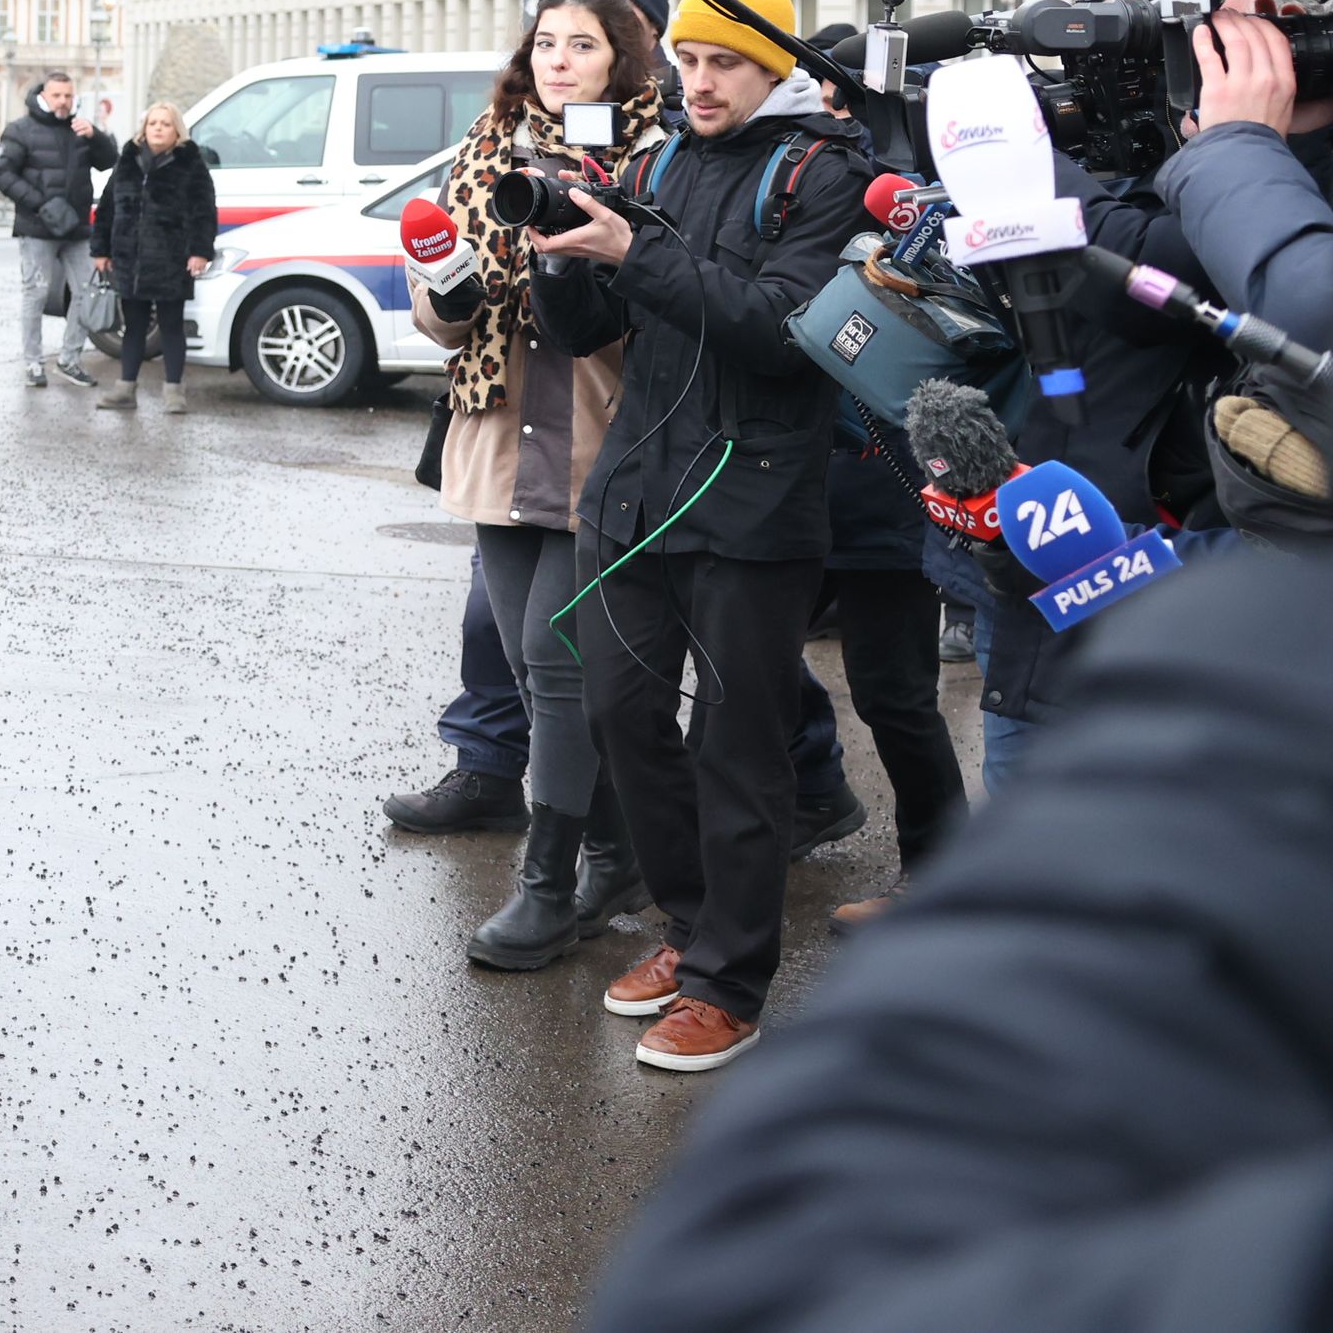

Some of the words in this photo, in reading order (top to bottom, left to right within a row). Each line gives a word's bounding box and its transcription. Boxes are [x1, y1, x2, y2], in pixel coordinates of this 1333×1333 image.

[411, 229, 450, 249] Kronen
[415, 239, 453, 258] Zeitung
[900, 226, 933, 264] HITRADIO
[926, 211, 945, 227] Ö3
[1017, 488, 1092, 551] 24
[1053, 569, 1114, 615] PULS
[1112, 549, 1155, 584] 24
